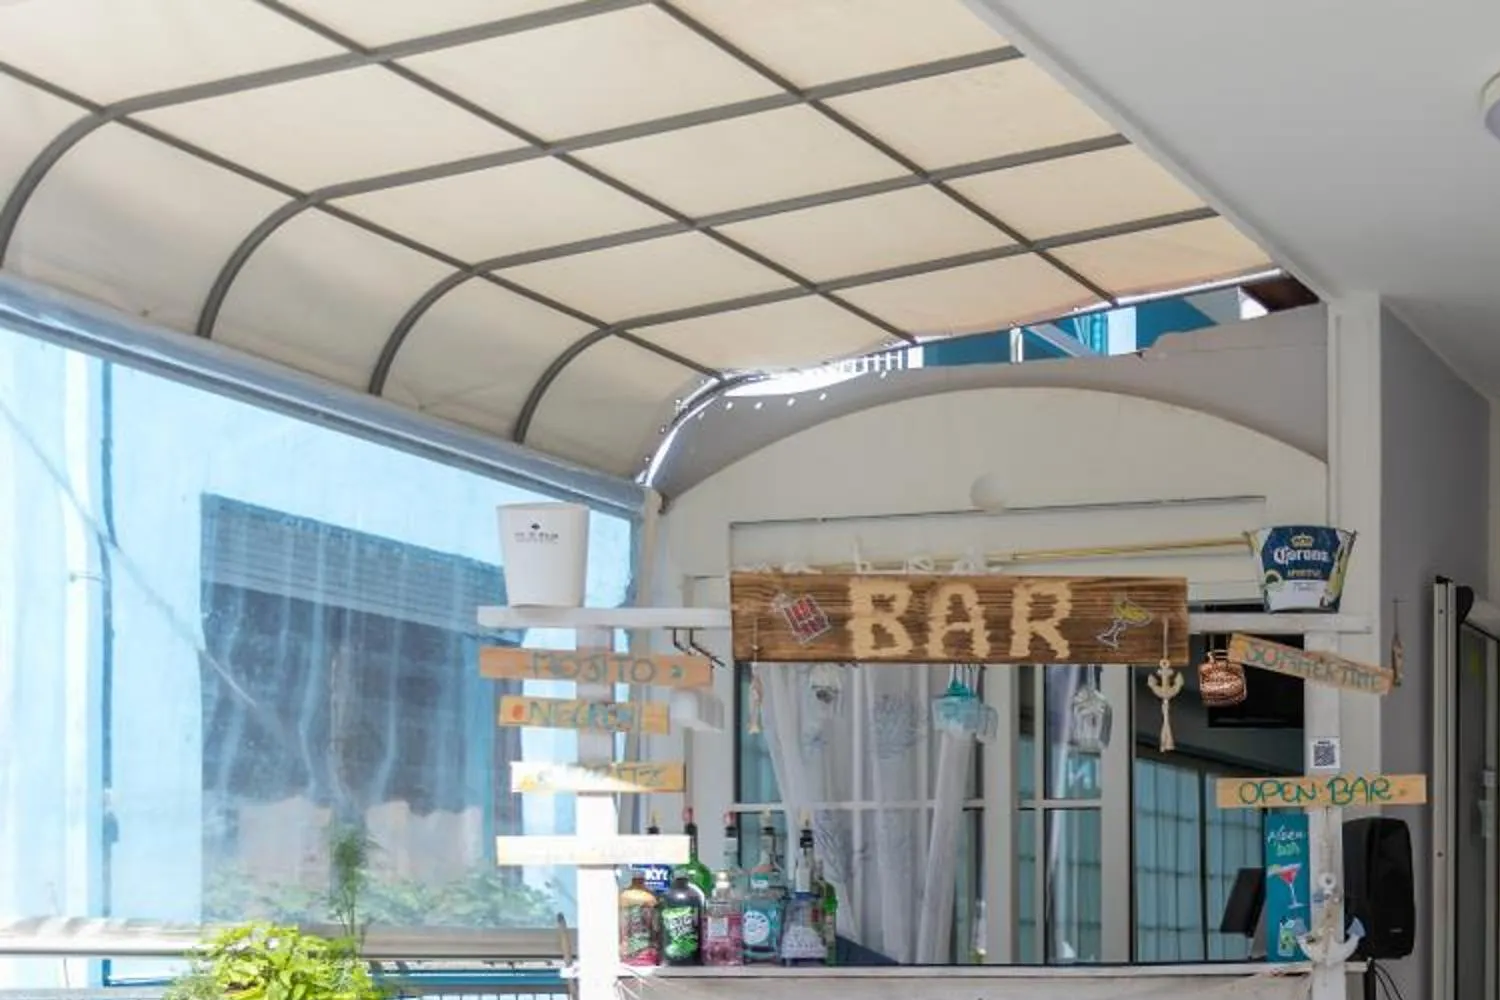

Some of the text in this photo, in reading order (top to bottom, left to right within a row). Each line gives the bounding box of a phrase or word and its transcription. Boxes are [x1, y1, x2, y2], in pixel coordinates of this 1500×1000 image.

[1273, 545, 1330, 565] Corona
[845, 577, 1073, 659] BAR
[532, 651, 656, 683] MOJITO
[1238, 776, 1397, 805] OPEN BAR
